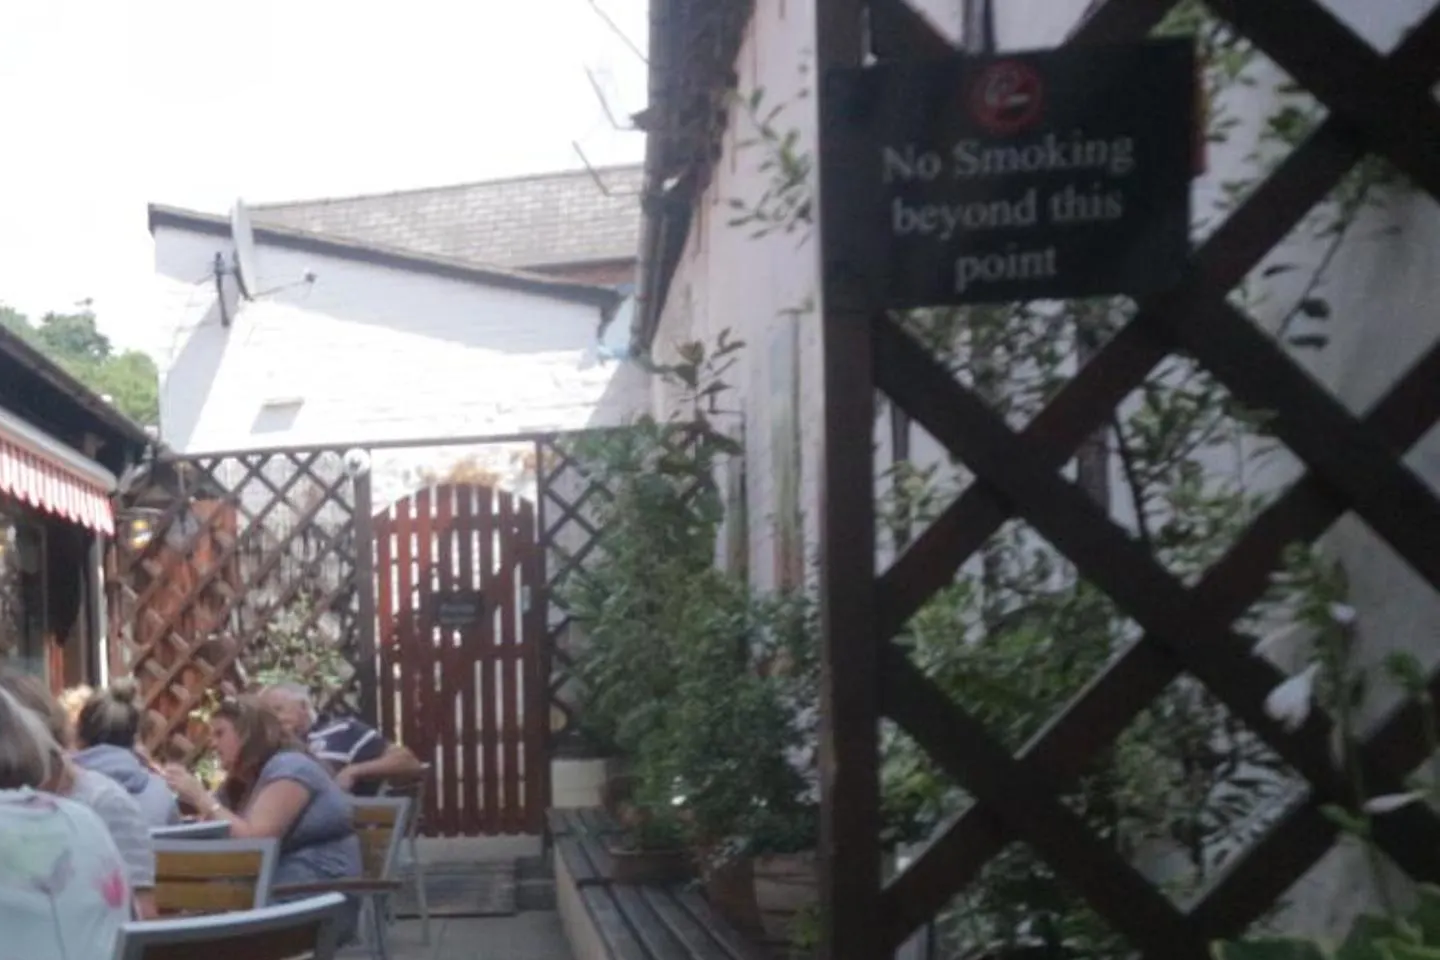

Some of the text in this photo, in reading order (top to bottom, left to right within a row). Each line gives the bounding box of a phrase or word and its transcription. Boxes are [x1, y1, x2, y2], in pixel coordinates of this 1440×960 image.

[880, 129, 1135, 182] No Smoking
[892, 181, 1124, 241] beyond this
[954, 241, 1058, 293] point
